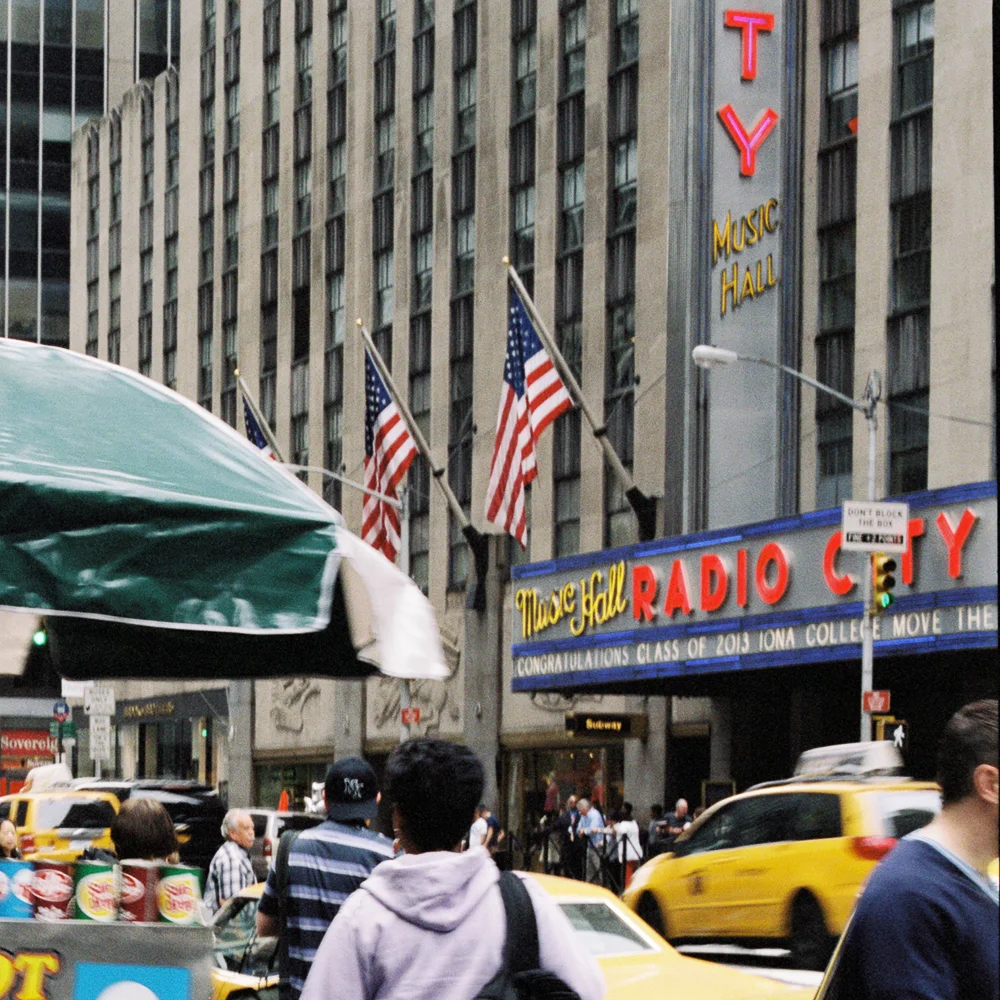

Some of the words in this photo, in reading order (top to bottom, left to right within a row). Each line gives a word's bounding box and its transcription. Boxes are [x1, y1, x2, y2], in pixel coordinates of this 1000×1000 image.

[712, 199, 779, 264] MUSIC
[720, 254, 777, 316] HALL
[859, 519, 873, 527] THE
[875, 508, 903, 518] BLOCK
[632, 541, 789, 622] RADIO
[823, 508, 977, 596] CTY
[515, 583, 576, 639] Music
[569, 560, 627, 636] Hall
[517, 644, 630, 678] CONGRATULATIONS
[636, 639, 680, 665] CLASS
[687, 636, 707, 658] OF
[716, 631, 750, 656] 2013
[758, 626, 796, 652] IONA
[892, 610, 942, 638] MOVE
[956, 603, 997, 631] THE
[0, 734, 59, 756] Sovereig
